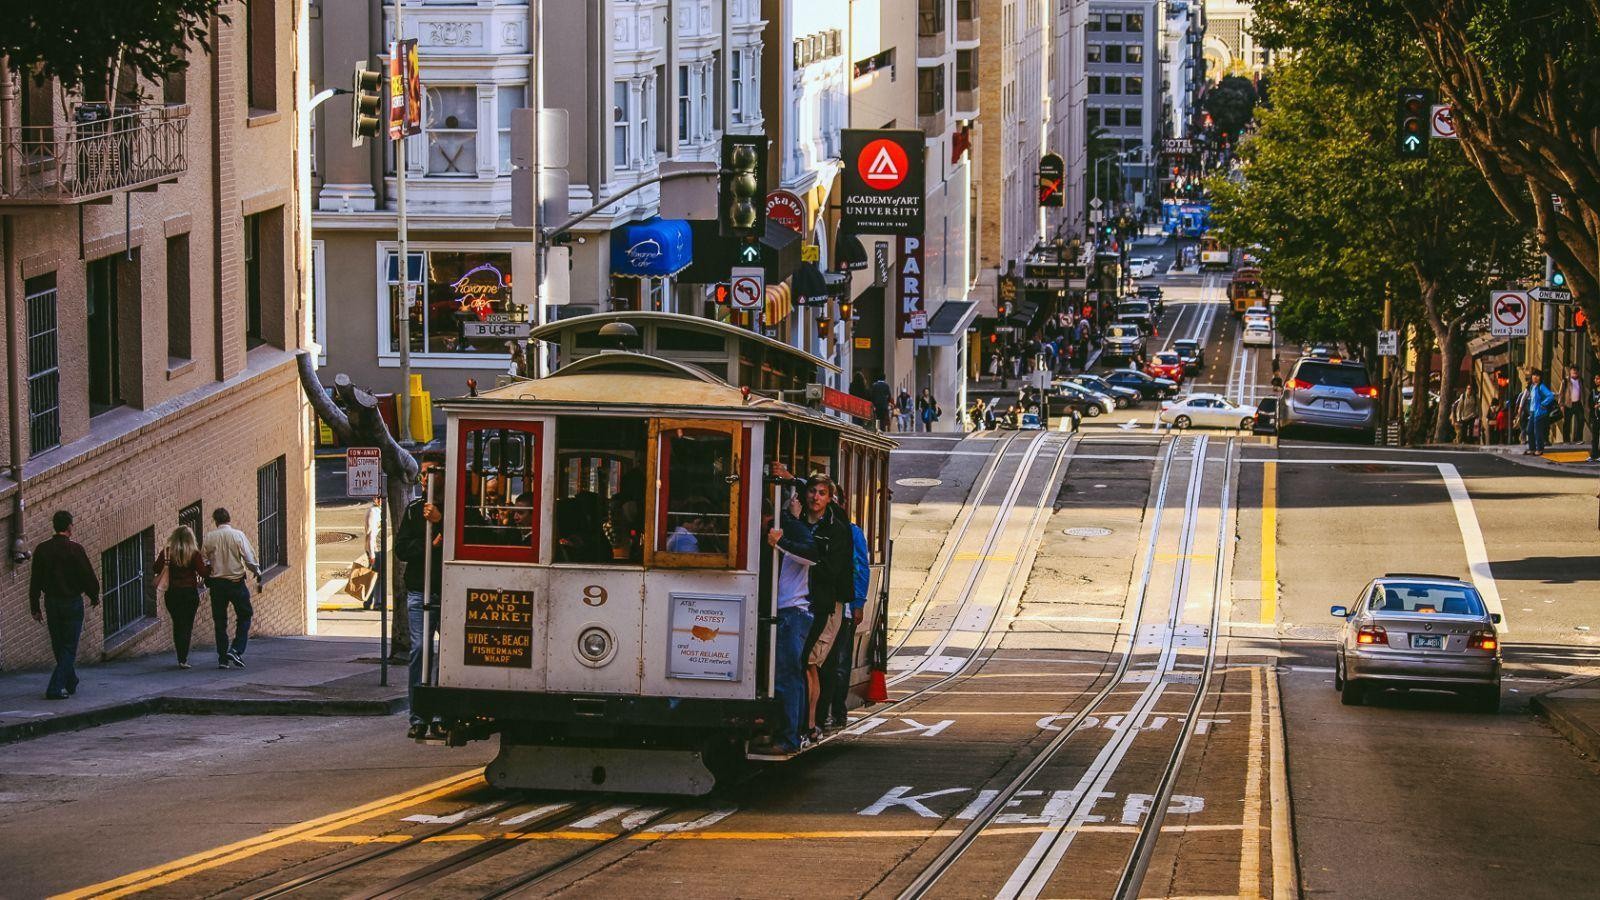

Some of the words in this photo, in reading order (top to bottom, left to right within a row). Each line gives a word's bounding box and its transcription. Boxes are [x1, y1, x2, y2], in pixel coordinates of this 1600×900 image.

[846, 196, 892, 205] ACADEMY
[900, 196, 920, 205] ART
[846, 206, 919, 216] UNIVERSITY
[903, 237, 920, 313] PARK
[454, 277, 499, 295] Roxanne
[458, 293, 496, 309] Cafe
[1555, 292, 1569, 300] WAY
[478, 323, 517, 335] BUSH
[348, 457, 358, 467] NO
[357, 458, 378, 466] STOPPING
[355, 470, 372, 478] ANY
[470, 592, 531, 605] POWELL
[582, 585, 609, 607] 9
[485, 604, 515, 612] AND
[468, 610, 531, 622] MARKET
[695, 615, 726, 624] FASTEST
[467, 633, 489, 645] HYDE
[502, 635, 530, 647] BEACH
[472, 646, 524, 656] FISHERMANS
[700, 651, 731, 659] RELIABLE
[484, 655, 511, 664] WHARF
[1036, 714, 1231, 736] OUT
[857, 785, 1205, 825] KEEP
